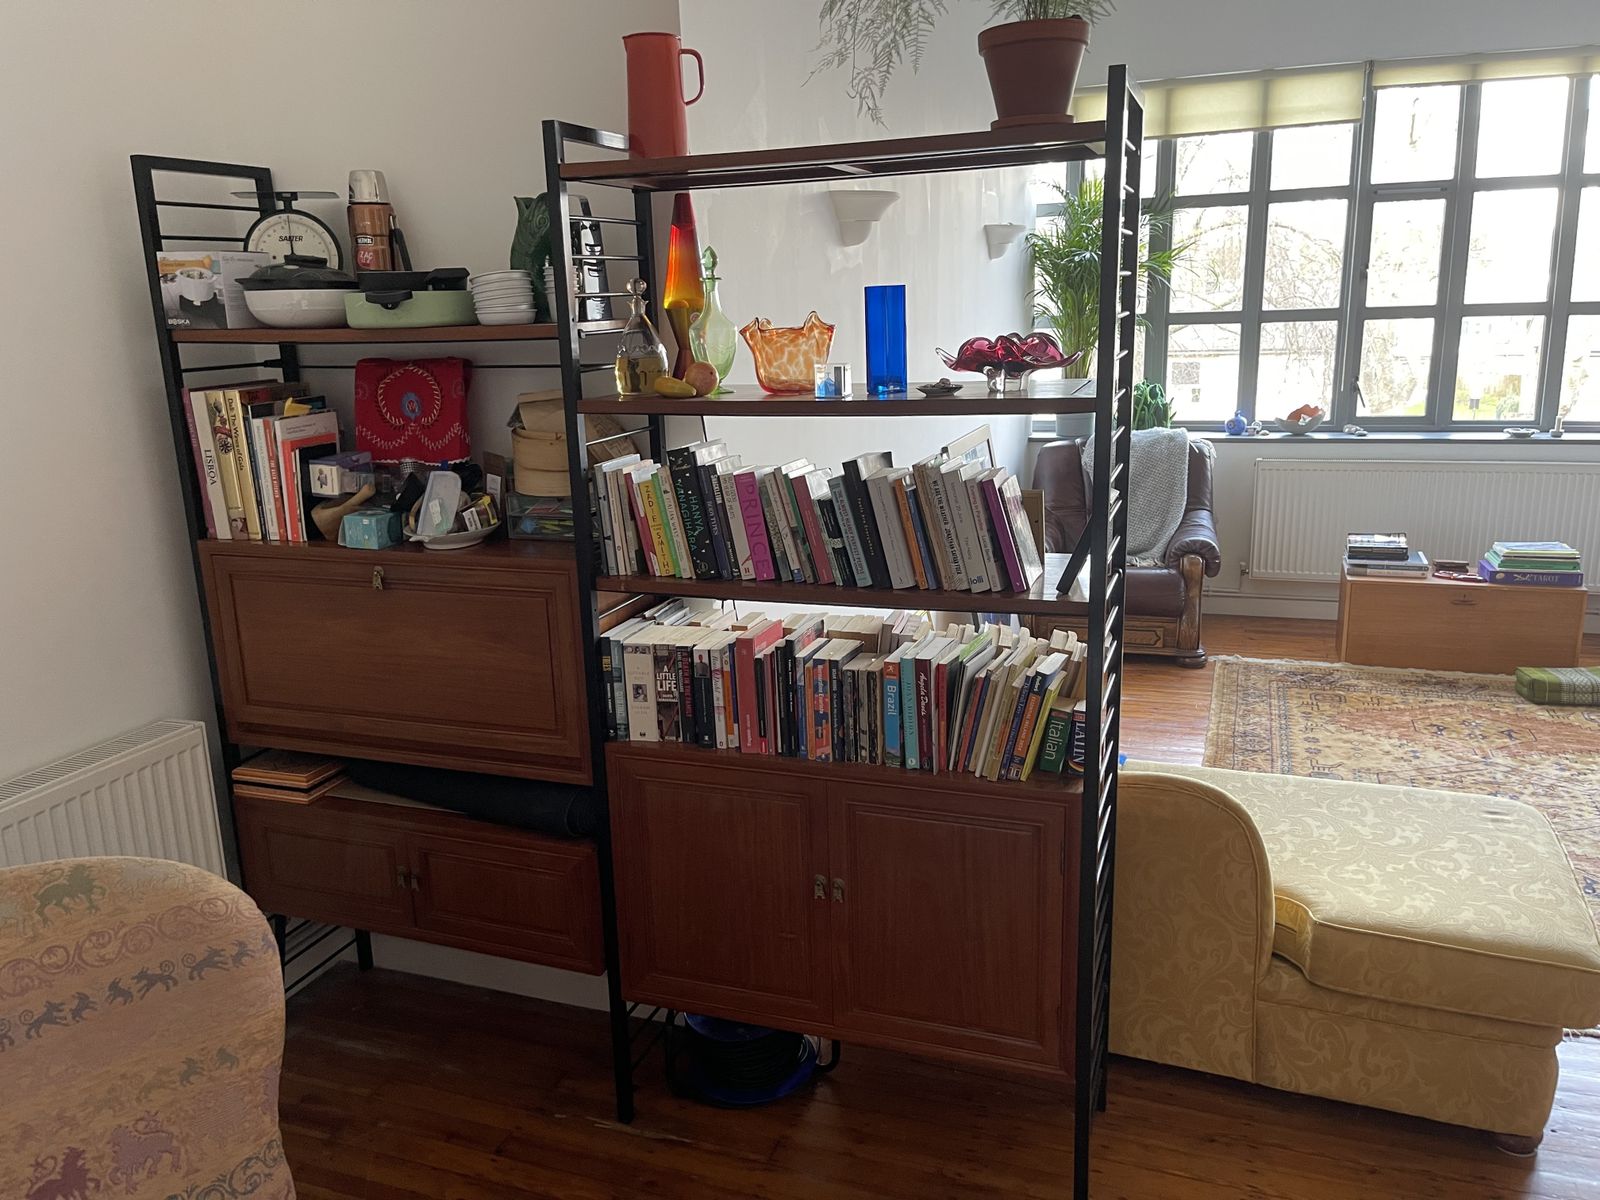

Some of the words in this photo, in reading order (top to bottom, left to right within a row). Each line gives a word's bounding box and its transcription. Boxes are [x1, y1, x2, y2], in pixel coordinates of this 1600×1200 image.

[230, 414, 238, 427] The
[232, 426, 241, 448] Wines
[204, 449, 217, 486] LISBOA
[675, 479, 697, 551] YANAGIHARA
[689, 495, 705, 533] HANYA
[939, 505, 949, 526] WEATHER
[967, 485, 978, 505] Evening
[975, 510, 985, 532] Paradise
[740, 484, 770, 572] PRINCE
[657, 531, 669, 569] SMITH
[658, 681, 677, 691] LIFE
[887, 685, 897, 716] Brazil
[917, 672, 928, 696] Angela
[920, 696, 928, 716] Davis
[1044, 720, 1065, 760] Italian
